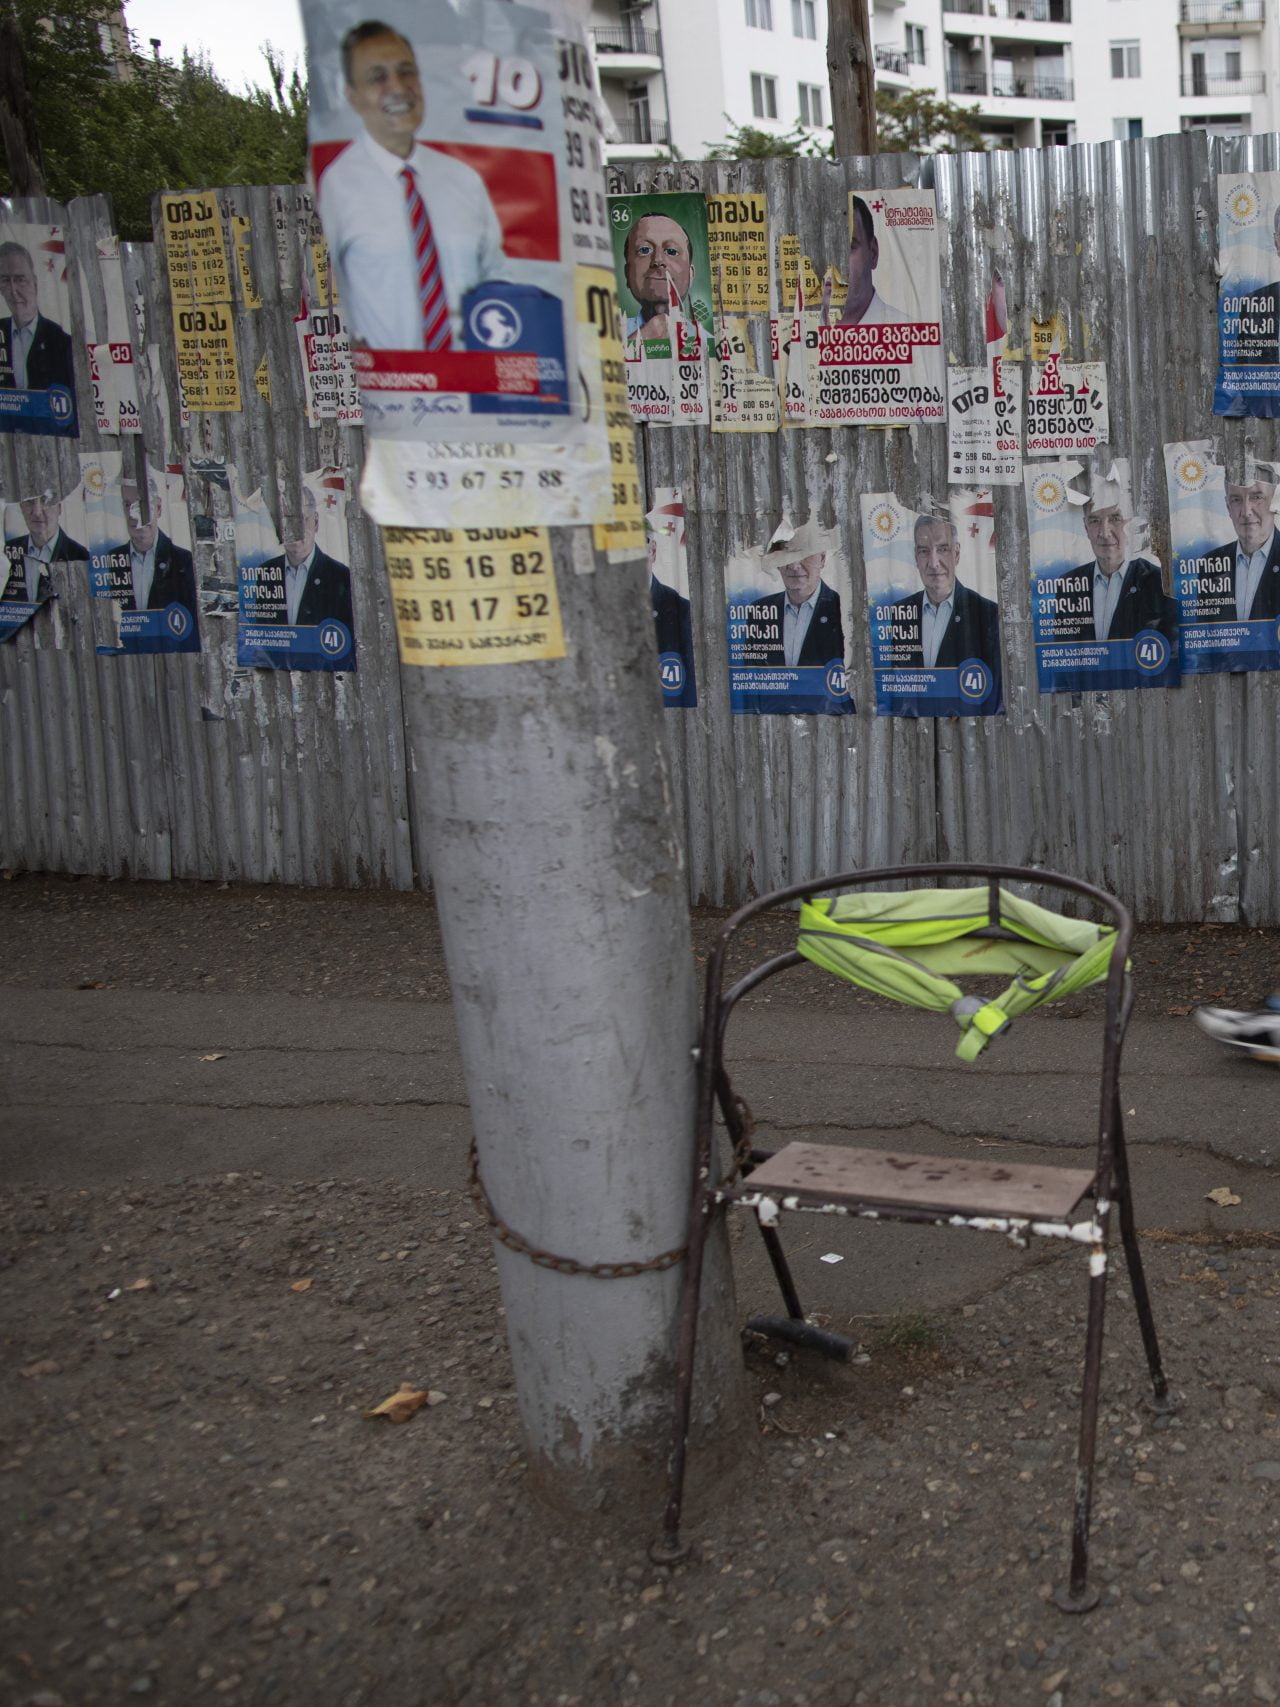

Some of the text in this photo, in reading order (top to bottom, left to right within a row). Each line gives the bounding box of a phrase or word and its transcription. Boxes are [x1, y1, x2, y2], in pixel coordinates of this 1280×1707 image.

[463, 53, 542, 110] 10
[612, 209, 629, 222] 36
[885, 206, 933, 218] სტრატეგია
[726, 266, 768, 276] 56 82
[727, 284, 768, 293] 81 52
[819, 325, 939, 345] იორგი ვაშაძე
[1034, 332, 1052, 343] 568
[820, 368, 900, 387] ავიწყოთ
[760, 400, 775, 408] 694
[820, 387, 944, 404] ღმშენებლობა,
[741, 413, 751, 422] 94
[767, 413, 775, 421] 02
[820, 407, 944, 420] ავამარცხოთ სიღარიბე!
[462, 472, 485, 489] 67
[500, 472, 523, 488] 57
[538, 471, 564, 486] 88
[424, 557, 450, 579] 56
[465, 556, 494, 578] 16
[512, 552, 544, 575] 82
[1180, 556, 1231, 574] გიორგი
[1038, 576, 1089, 594] გიორგი
[1181, 576, 1231, 595] ვოლსკი
[432, 599, 455, 622] 81
[471, 598, 498, 621] 17
[517, 594, 549, 617] 52
[730, 605, 778, 621] გიორგი
[1039, 597, 1091, 614] ვოლსკი
[731, 624, 779, 639] ვოლსკი
[1141, 644, 1157, 661] 41
[662, 665, 680, 682] 41
